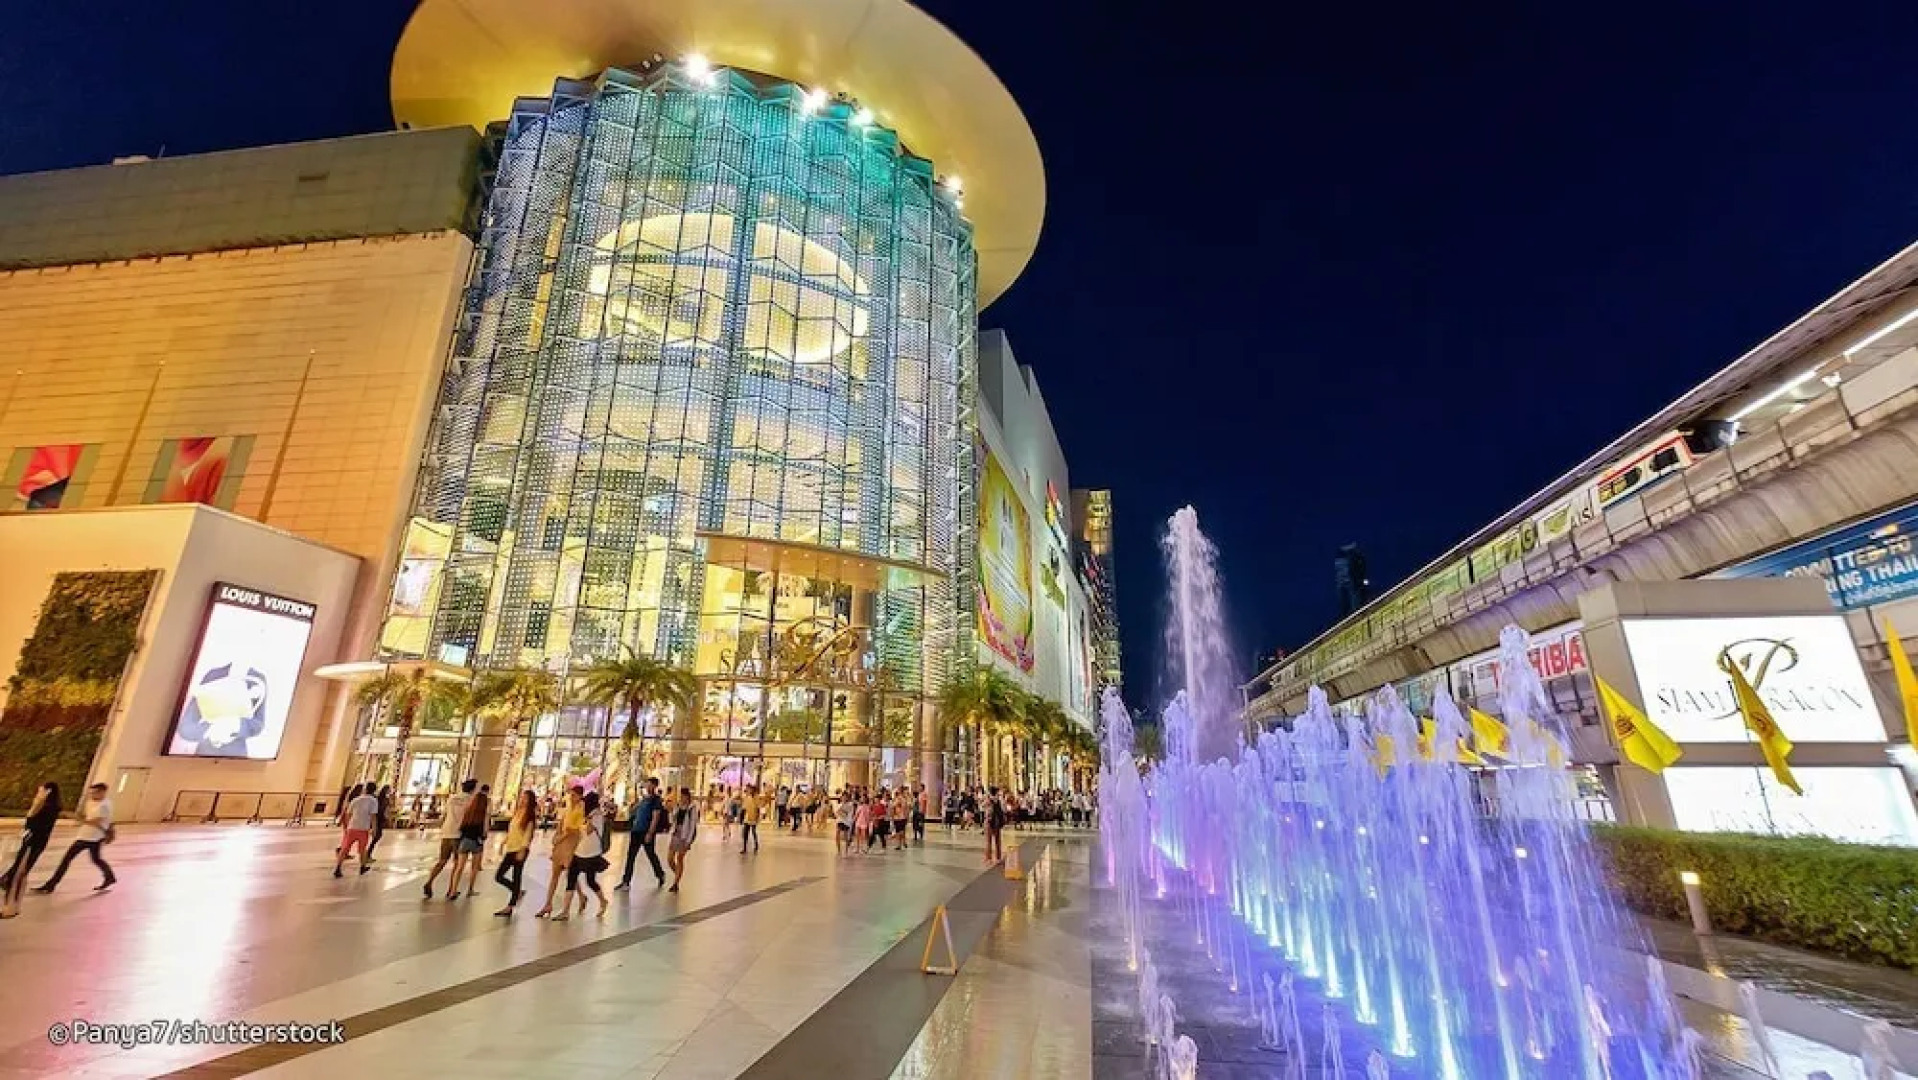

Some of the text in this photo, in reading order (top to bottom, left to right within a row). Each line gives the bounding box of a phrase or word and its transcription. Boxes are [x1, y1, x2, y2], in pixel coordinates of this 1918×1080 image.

[221, 586, 314, 617] LOUIS VUITTON
[1489, 634, 1587, 690] THIBA
[1712, 636, 1864, 720] PRAGON
